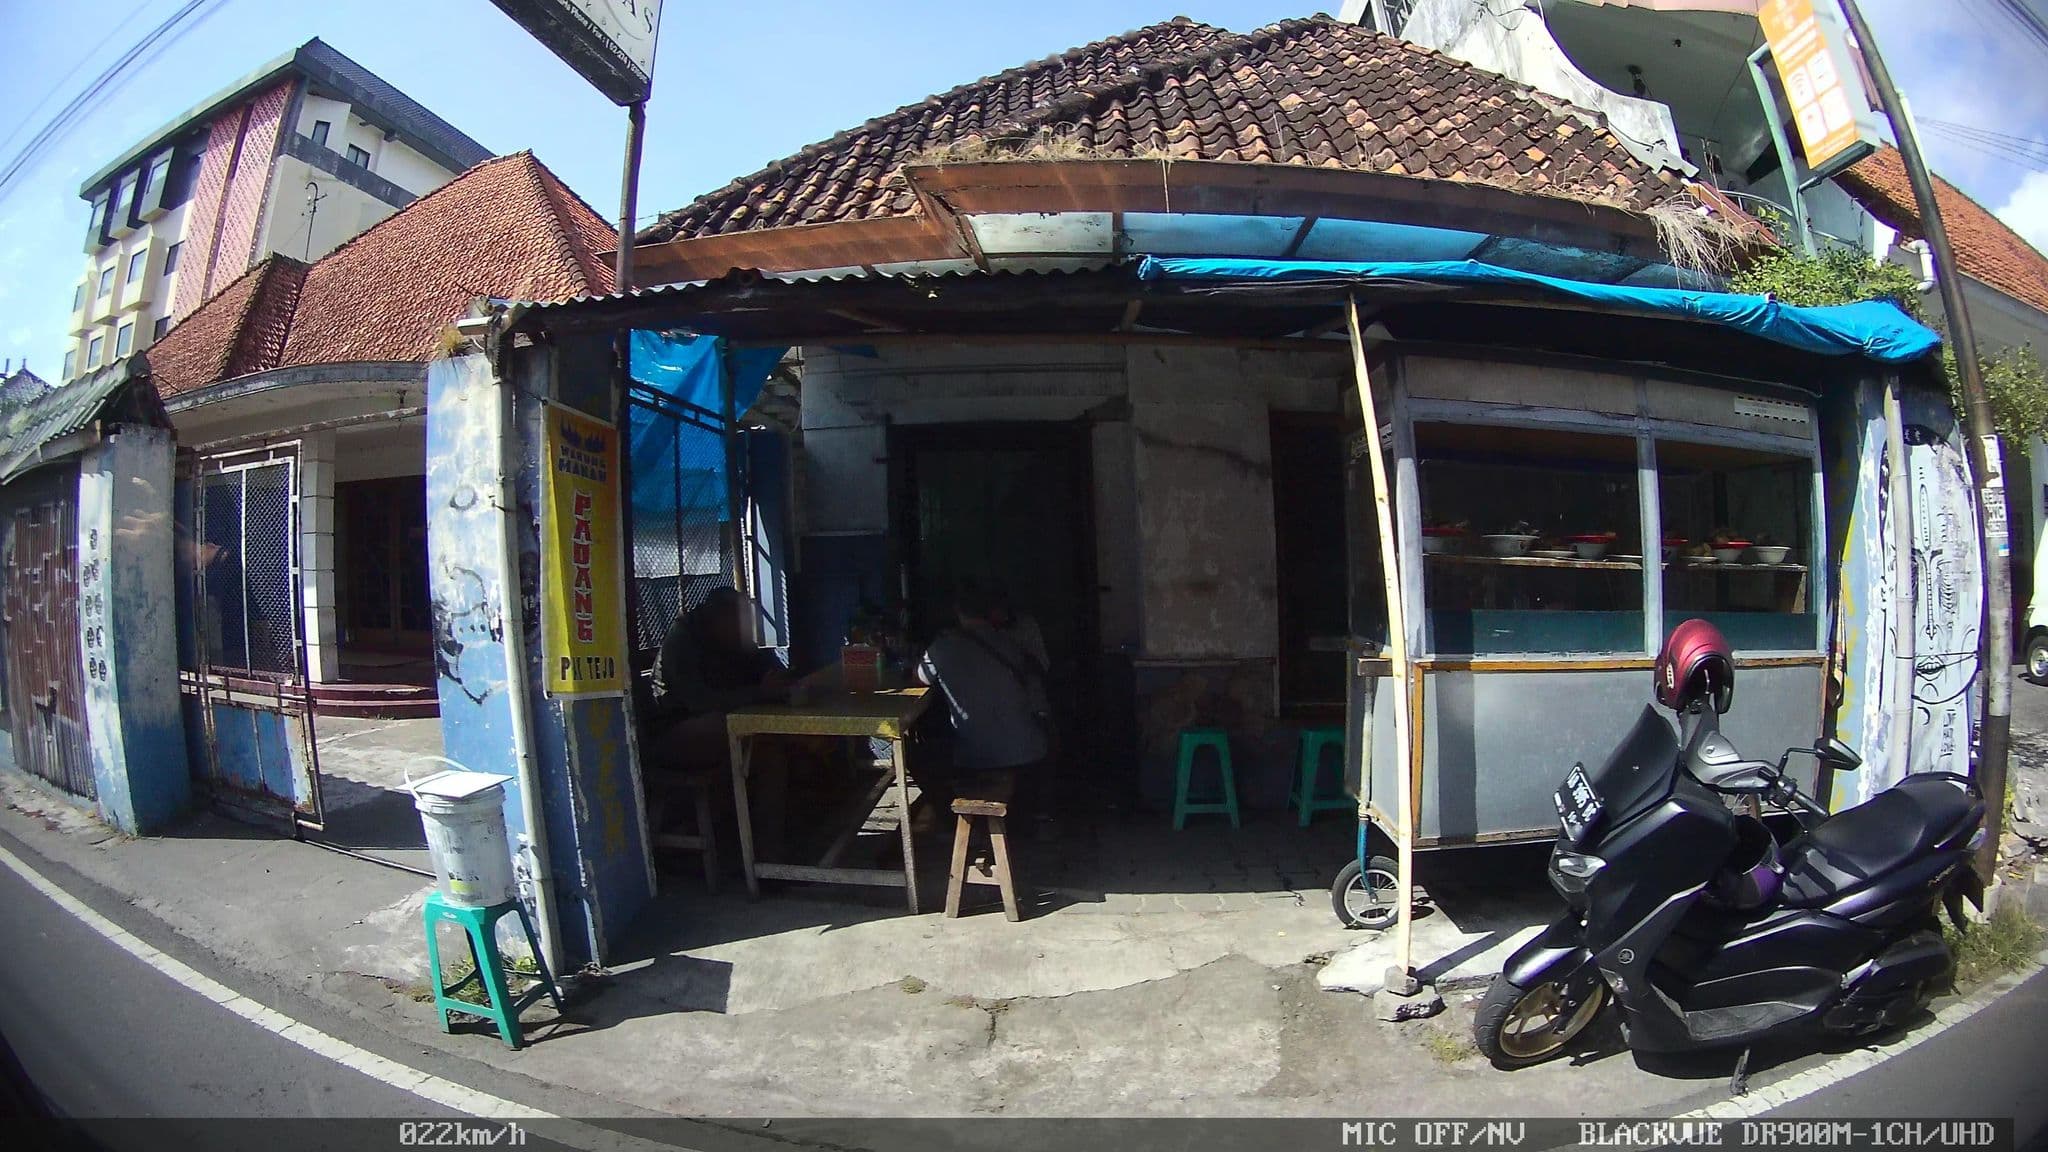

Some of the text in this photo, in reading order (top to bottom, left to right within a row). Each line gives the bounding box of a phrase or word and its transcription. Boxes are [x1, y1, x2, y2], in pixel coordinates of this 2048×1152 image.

[558, 457, 608, 482] MAKAN
[572, 489, 593, 644] PADANG
[586, 656, 615, 680] TEJO
